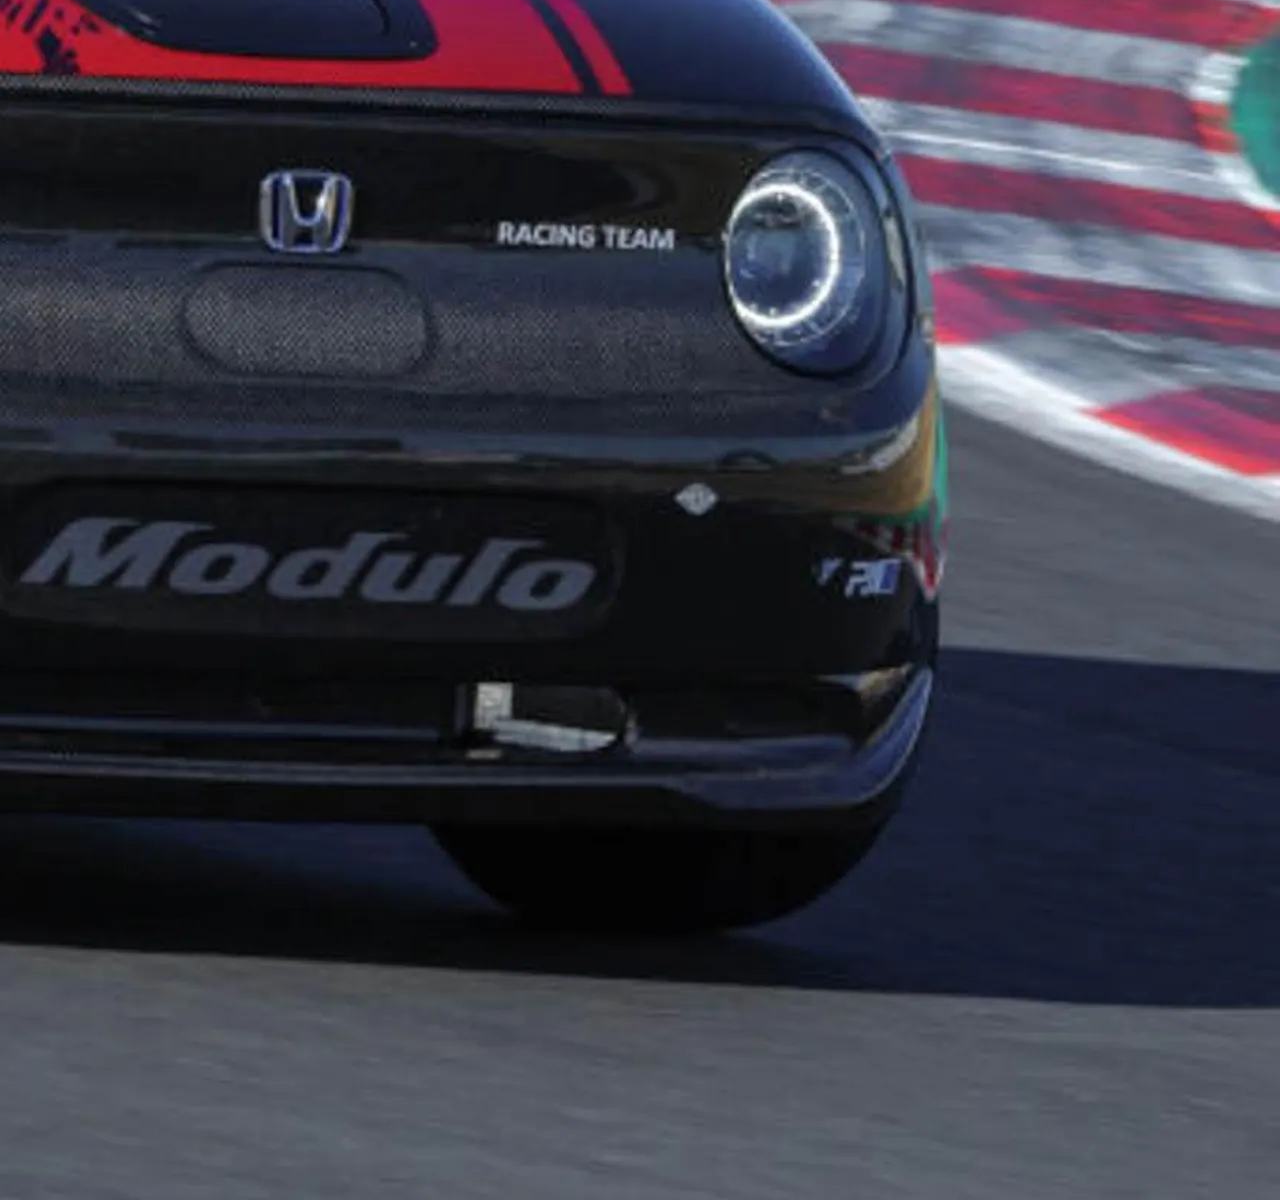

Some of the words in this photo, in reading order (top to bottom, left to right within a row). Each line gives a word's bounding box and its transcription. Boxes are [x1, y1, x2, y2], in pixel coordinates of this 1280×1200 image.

[497, 221, 595, 249] RACING
[602, 225, 675, 250] TEAM
[20, 517, 596, 610] Modulo
